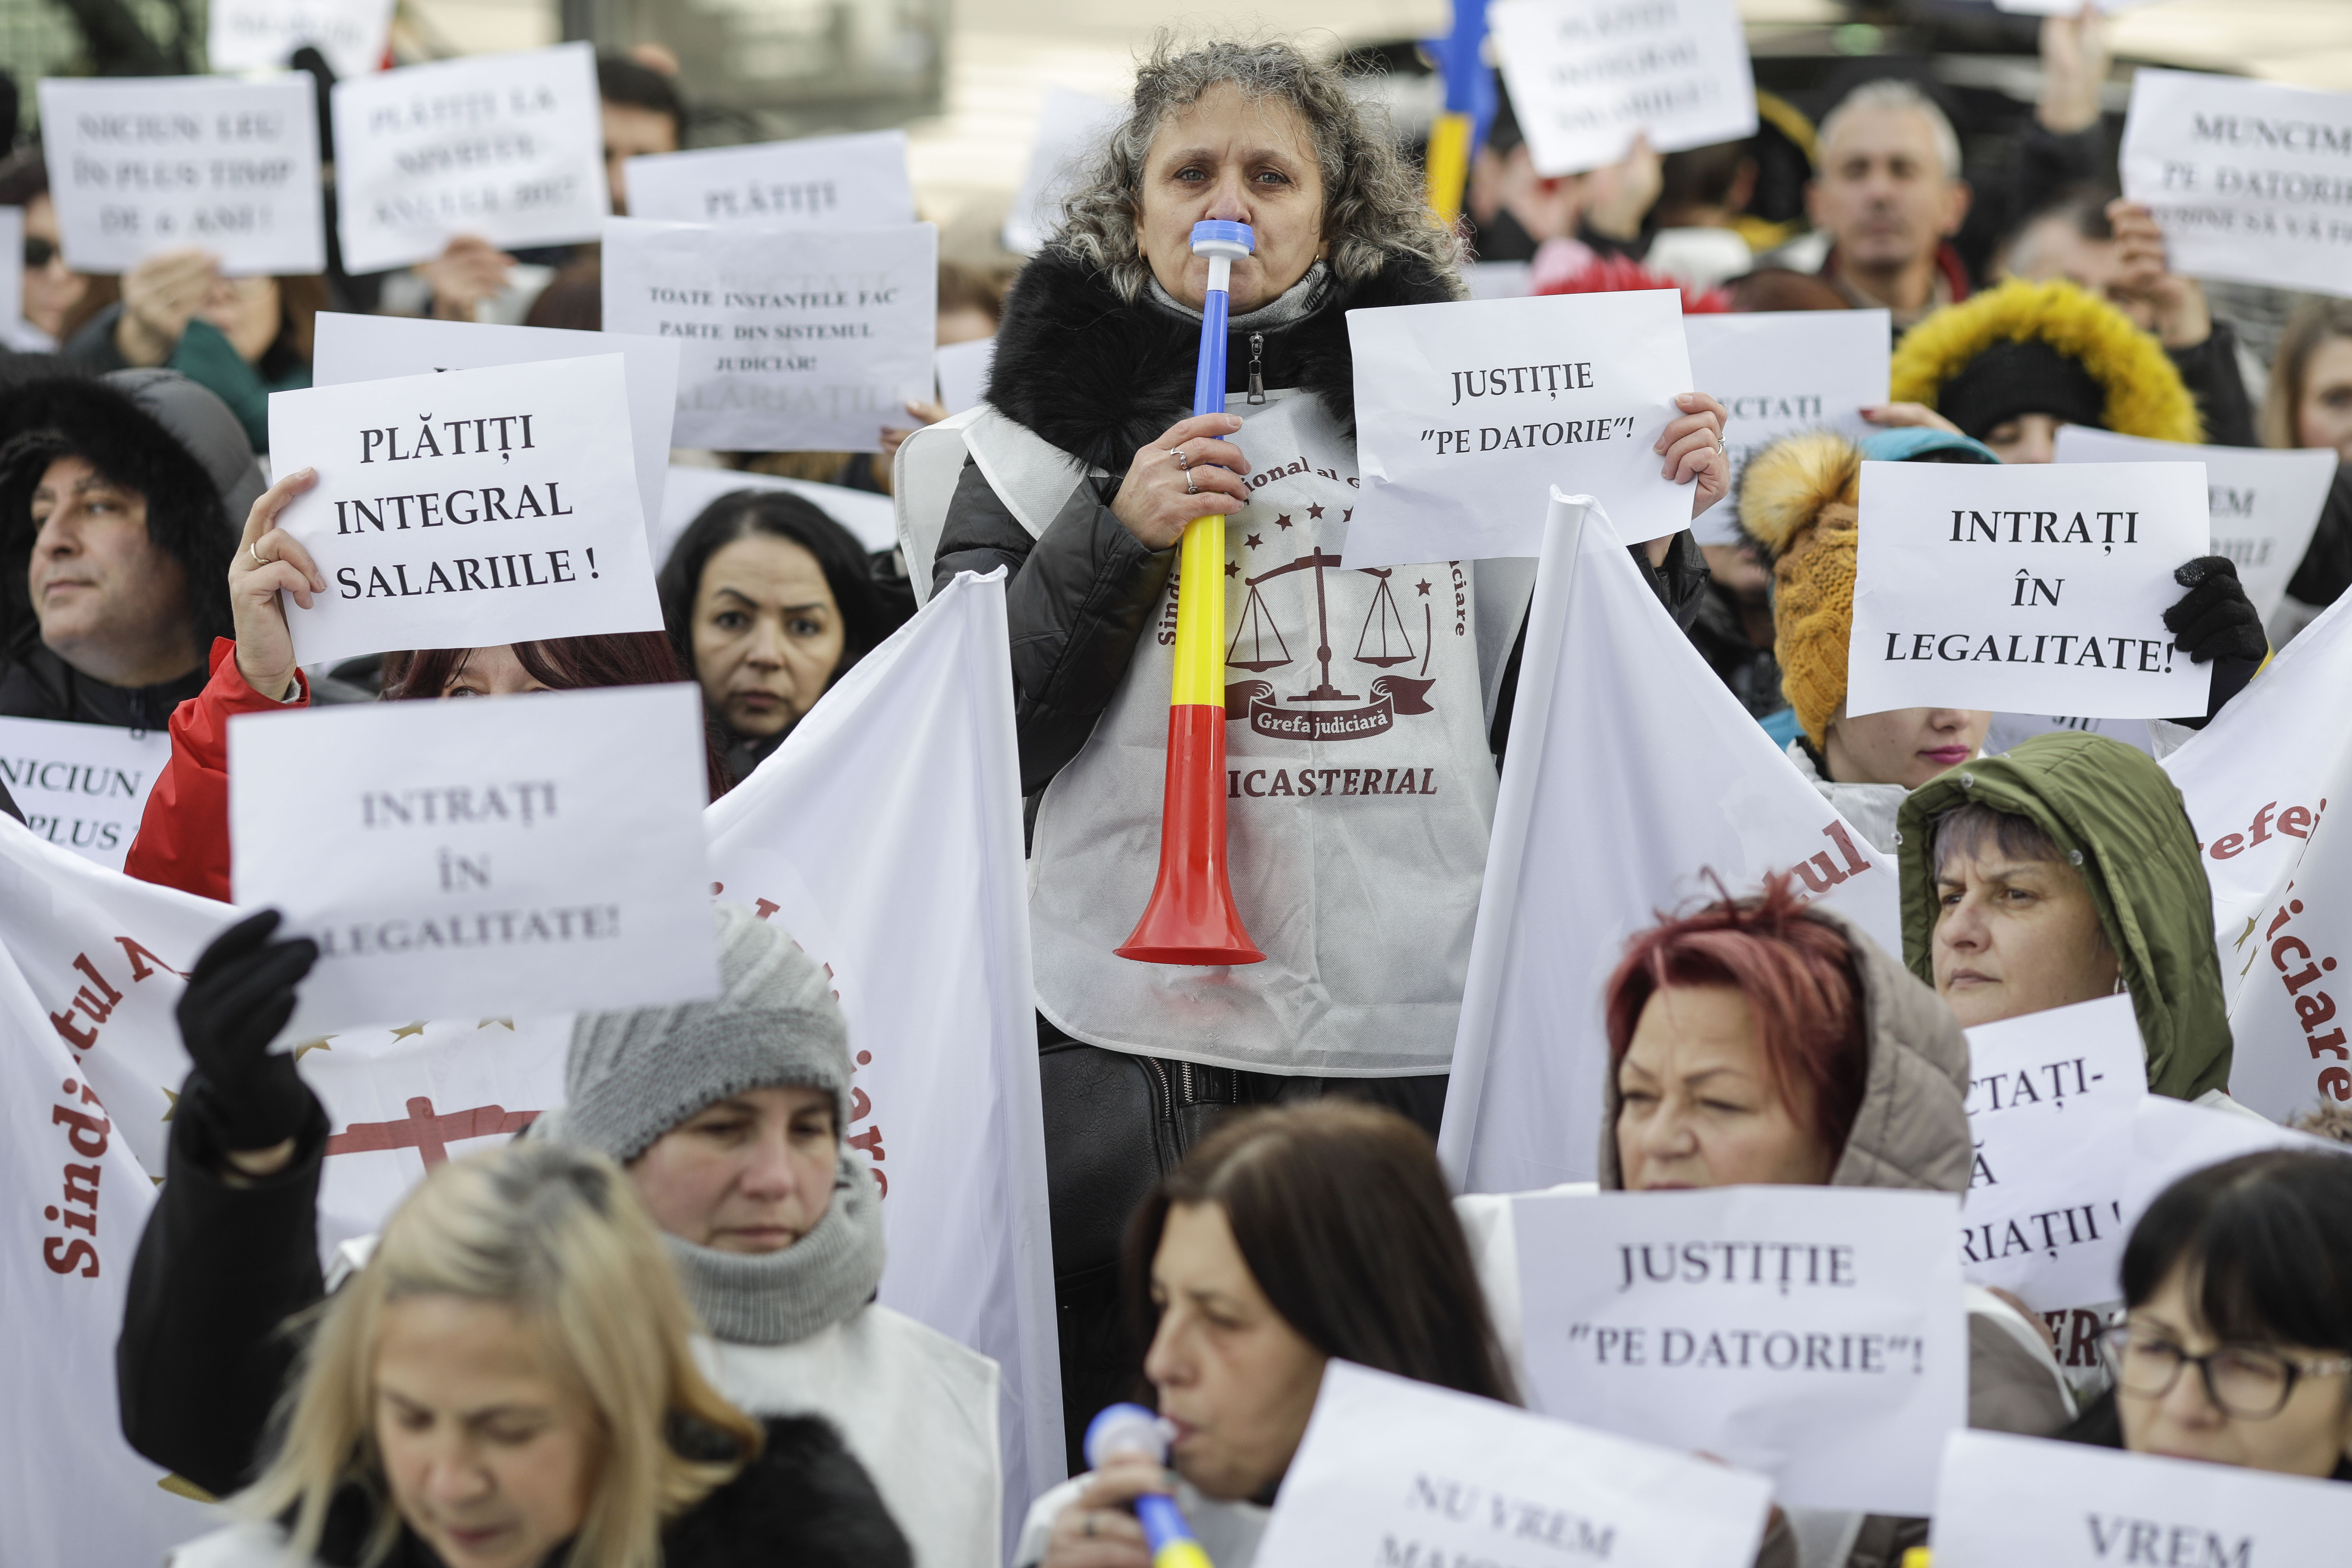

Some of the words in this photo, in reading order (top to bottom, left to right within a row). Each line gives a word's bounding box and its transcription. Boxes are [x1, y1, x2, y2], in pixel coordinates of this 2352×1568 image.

[77, 113, 201, 145] NICIUN
[216, 112, 283, 142] LEU
[2192, 113, 2352, 155] MUNCIM
[118, 160, 199, 188] PLUS
[209, 159, 295, 188] TIMP
[704, 180, 839, 217] PLĂTIȚI
[100, 205, 141, 235] DE
[649, 286, 714, 308] TOATE
[724, 290, 848, 313] INSTANȚELE
[858, 288, 898, 308] FAC
[659, 320, 726, 341] PARTE
[733, 324, 770, 341] DIN
[772, 323, 874, 341] SISTEMUL
[714, 355, 817, 372] JUDICIAR!
[1451, 362, 1594, 407] JUSTIȚIE
[360, 413, 535, 464] PLĂTIȚI
[1317, 468, 1340, 482] al
[334, 482, 573, 535] INTEGRAL
[1949, 510, 2139, 556] INTRAȚI
[337, 550, 576, 599] SALARIILE
[2011, 568, 2065, 606] ÎN
[1884, 631, 2174, 674] LEGALITATE!
[1257, 713, 1311, 733] Grefa
[1314, 710, 1388, 739] judiciară
[0, 756, 142, 800] NICIUN
[1228, 768, 1437, 798] ICASTERIAL
[361, 779, 558, 829] INTRAȚI
[29, 814, 123, 851] PLUS
[438, 849, 493, 895] ÎN
[1617, 1242, 1856, 1295] JUSTIȚIE
[1409, 1475, 1478, 1522] NU
[1489, 1494, 1618, 1558] VREM
[2085, 1512, 2255, 1568] VREM
